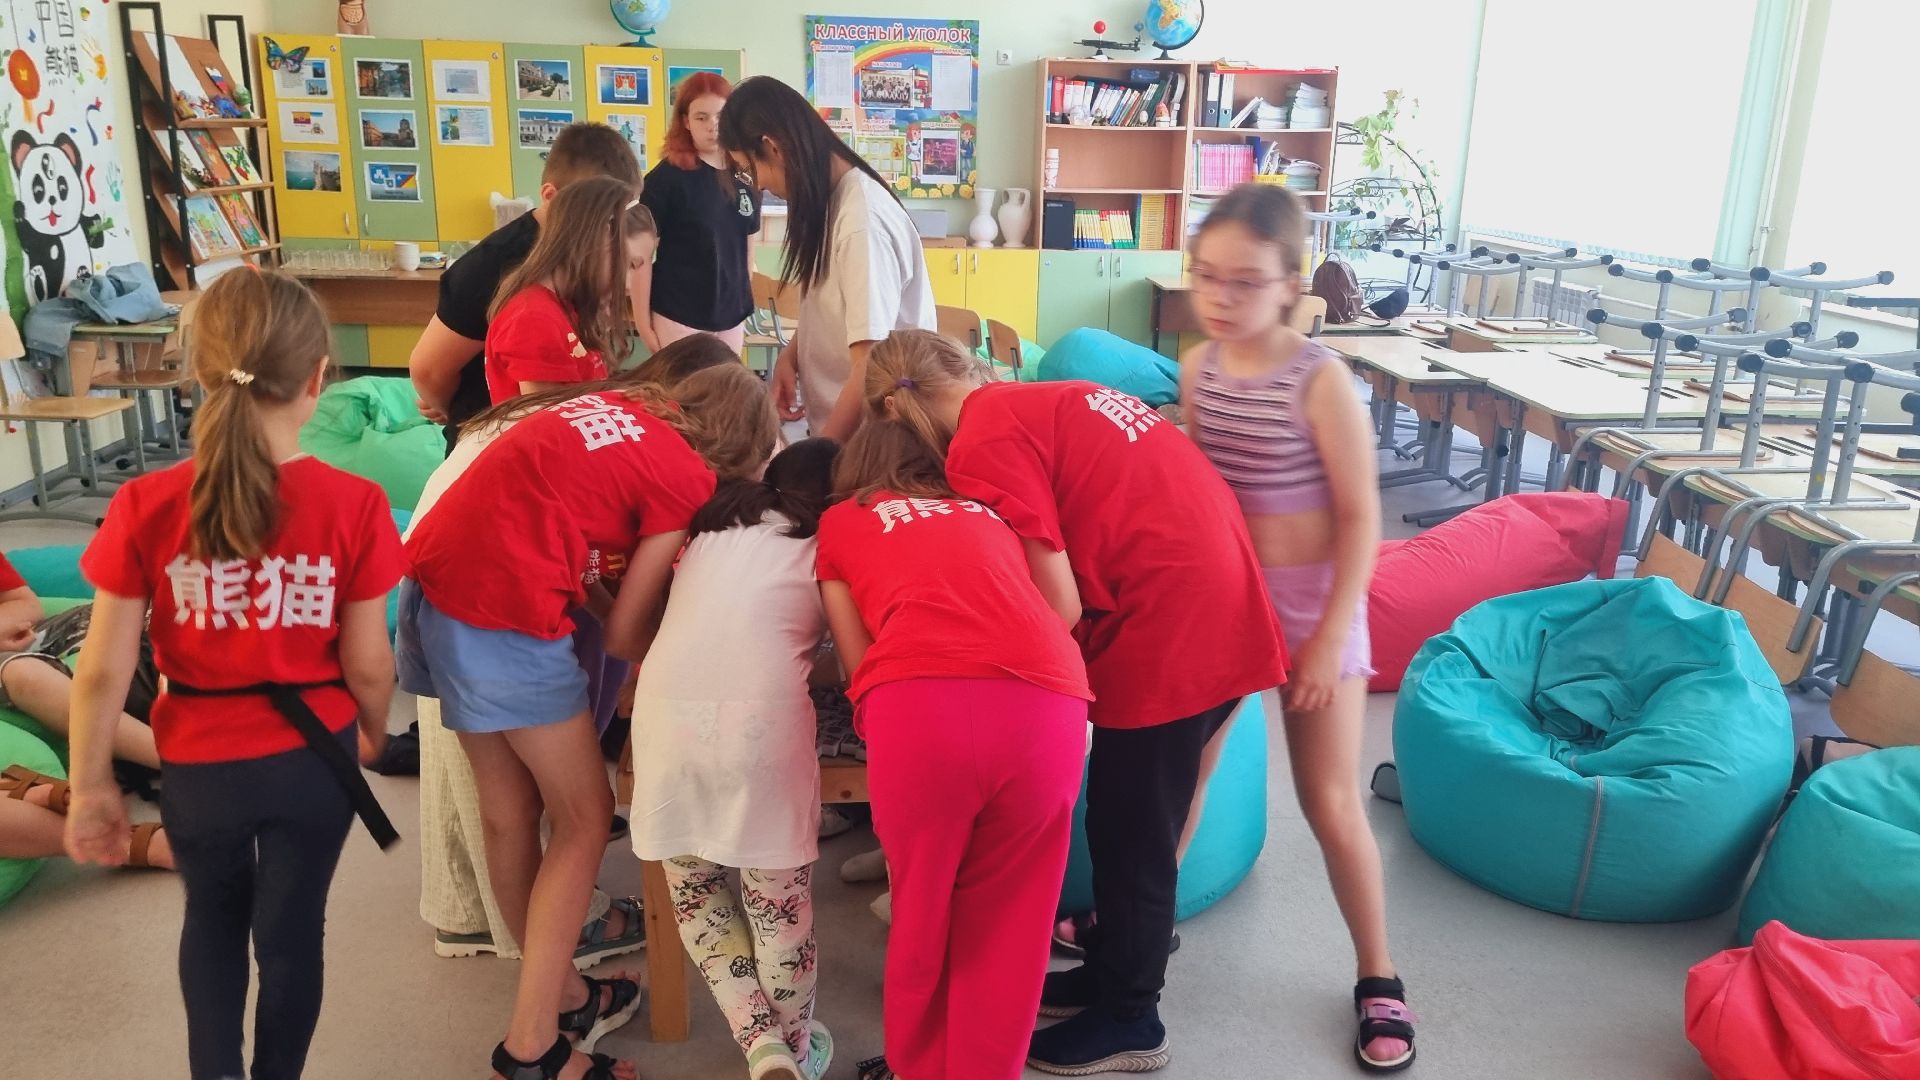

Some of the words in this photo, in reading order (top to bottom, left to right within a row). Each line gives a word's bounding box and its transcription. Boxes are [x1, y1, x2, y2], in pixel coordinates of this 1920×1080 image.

[815, 23, 903, 41] КЛАССНЫЙ
[908, 27, 971, 42] УГОЛОК
[164, 553, 336, 630] 熊猫
